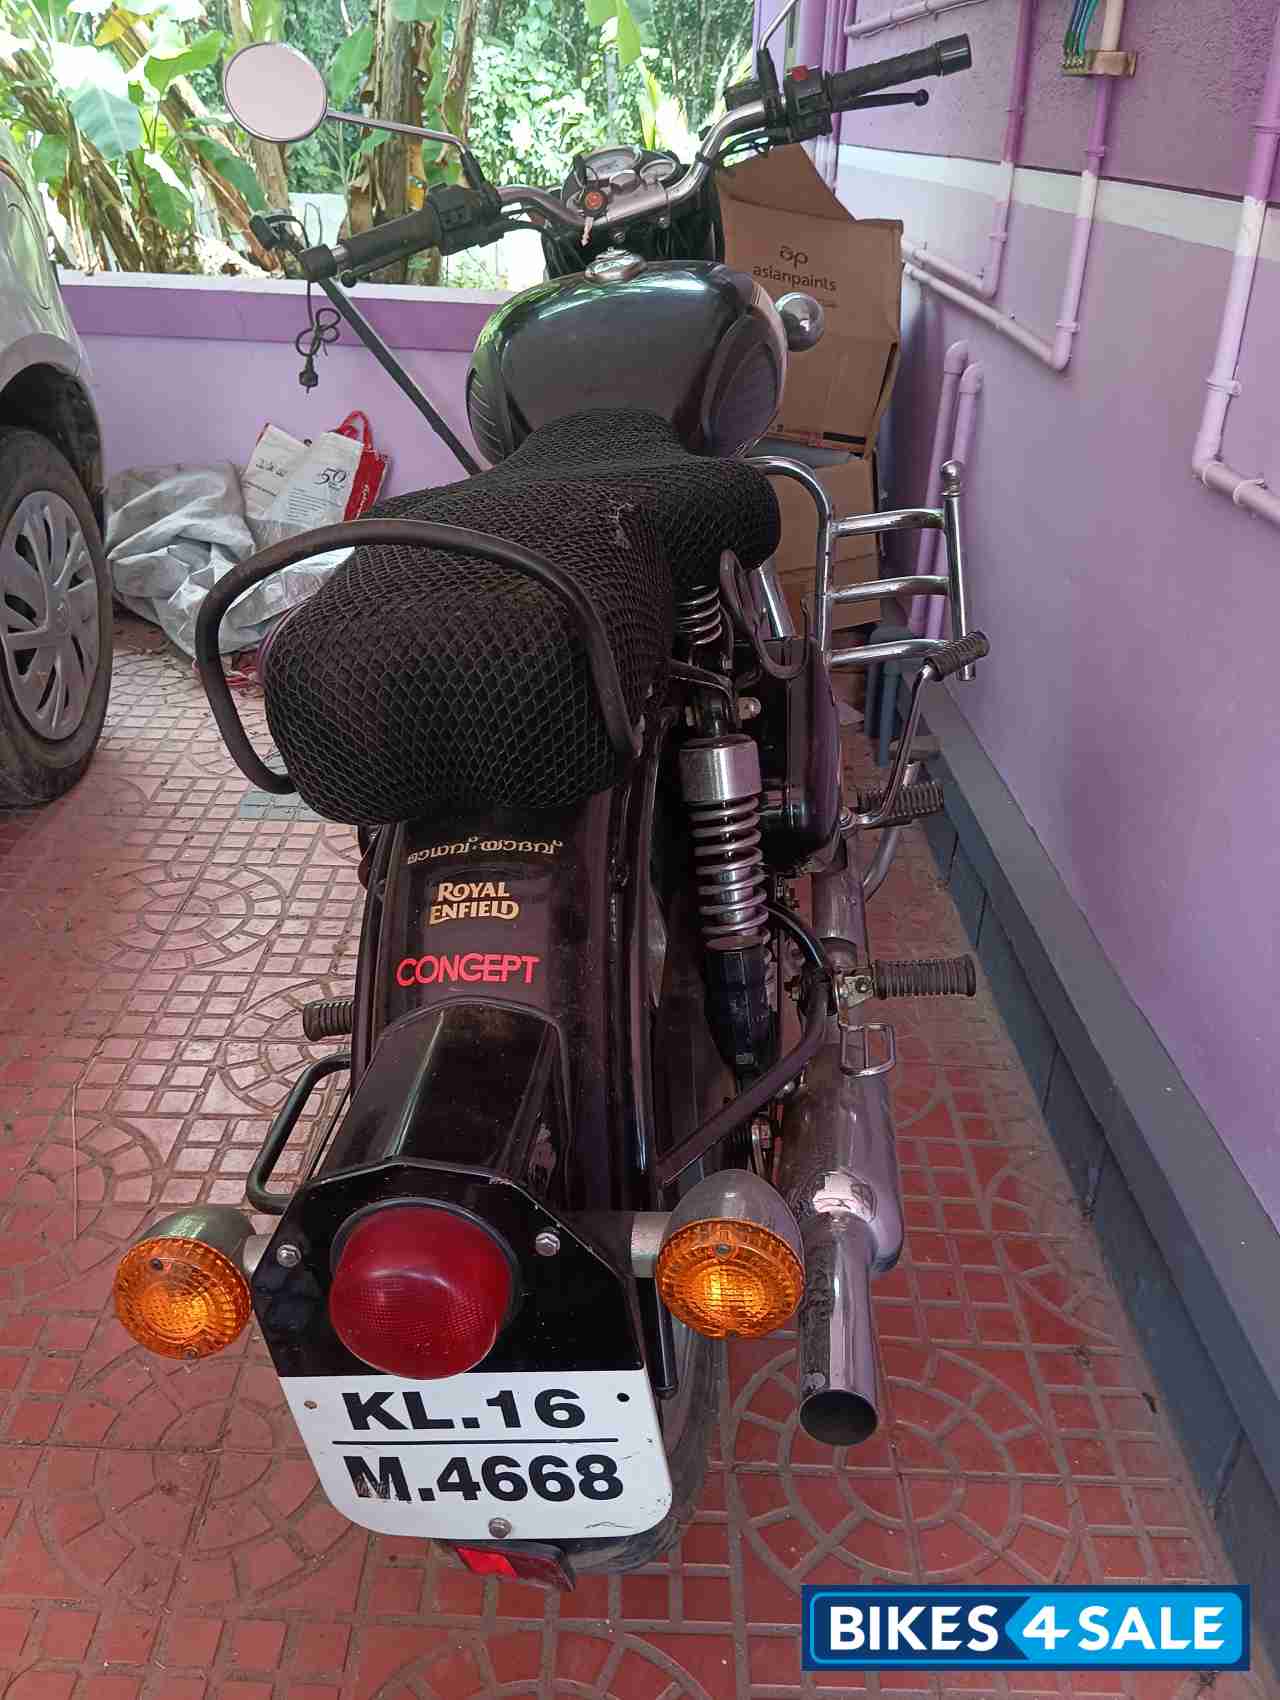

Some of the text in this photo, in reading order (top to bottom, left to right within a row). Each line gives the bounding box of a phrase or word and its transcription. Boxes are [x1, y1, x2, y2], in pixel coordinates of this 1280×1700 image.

[752, 265, 837, 292] asianpaints
[438, 882, 510, 902] ROYAL
[429, 901, 520, 925] ENFIELD
[341, 1388, 586, 1430] KL.16
[343, 1454, 624, 1503] M.4668
